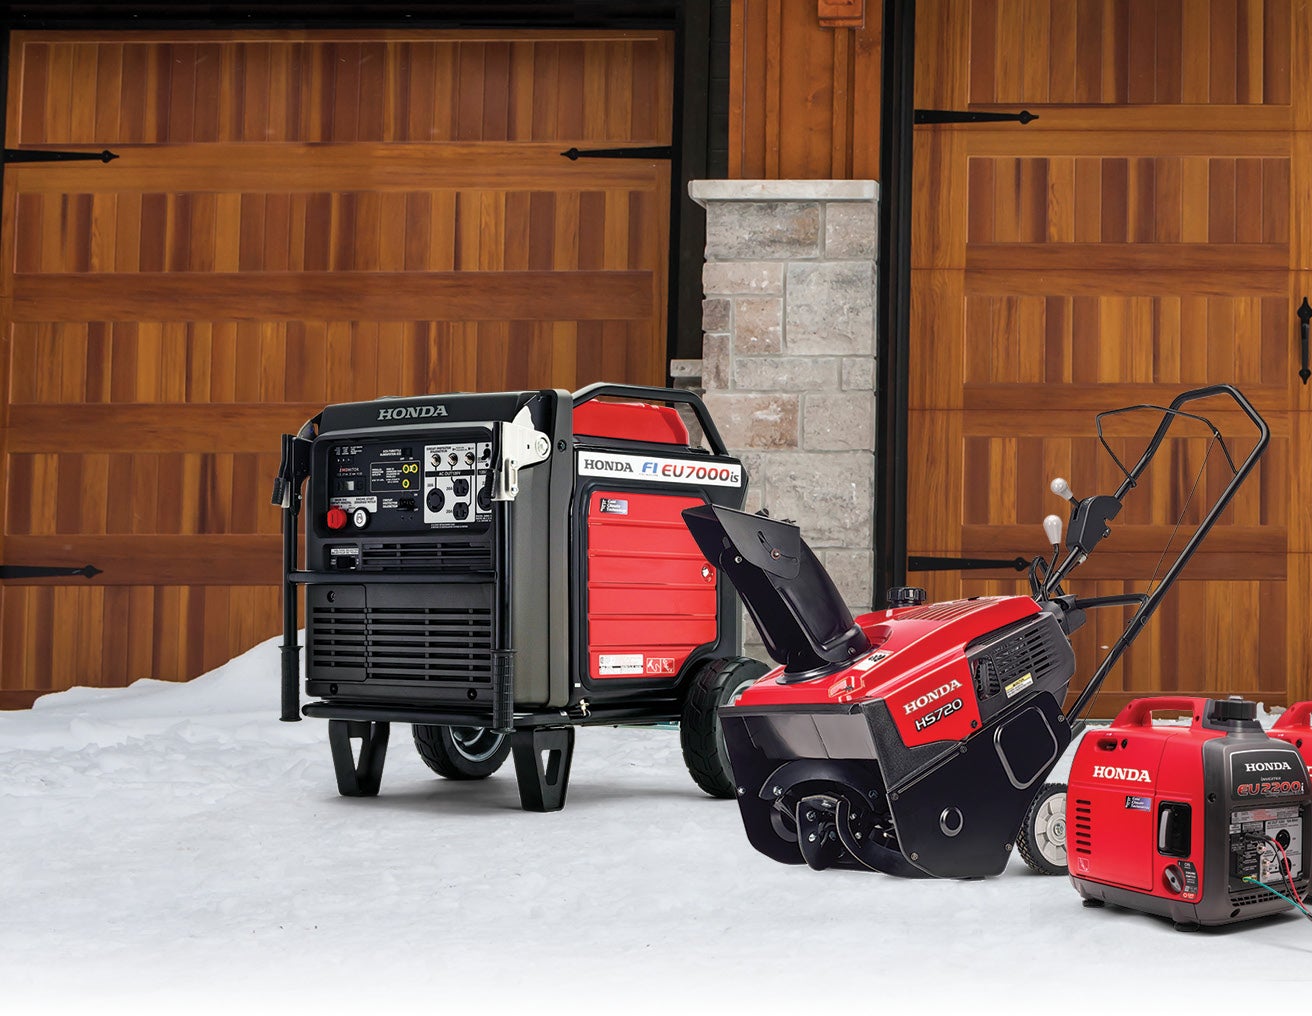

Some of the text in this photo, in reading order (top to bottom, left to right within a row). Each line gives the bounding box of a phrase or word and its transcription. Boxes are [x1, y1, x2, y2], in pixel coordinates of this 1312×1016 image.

[377, 405, 448, 420] HONDA
[584, 459, 739, 483] HONDA FI EU7000is
[903, 679, 963, 715] HONDA
[914, 698, 964, 732] HS720
[1092, 765, 1152, 783] HONDA
[1244, 762, 1292, 772] HONDA
